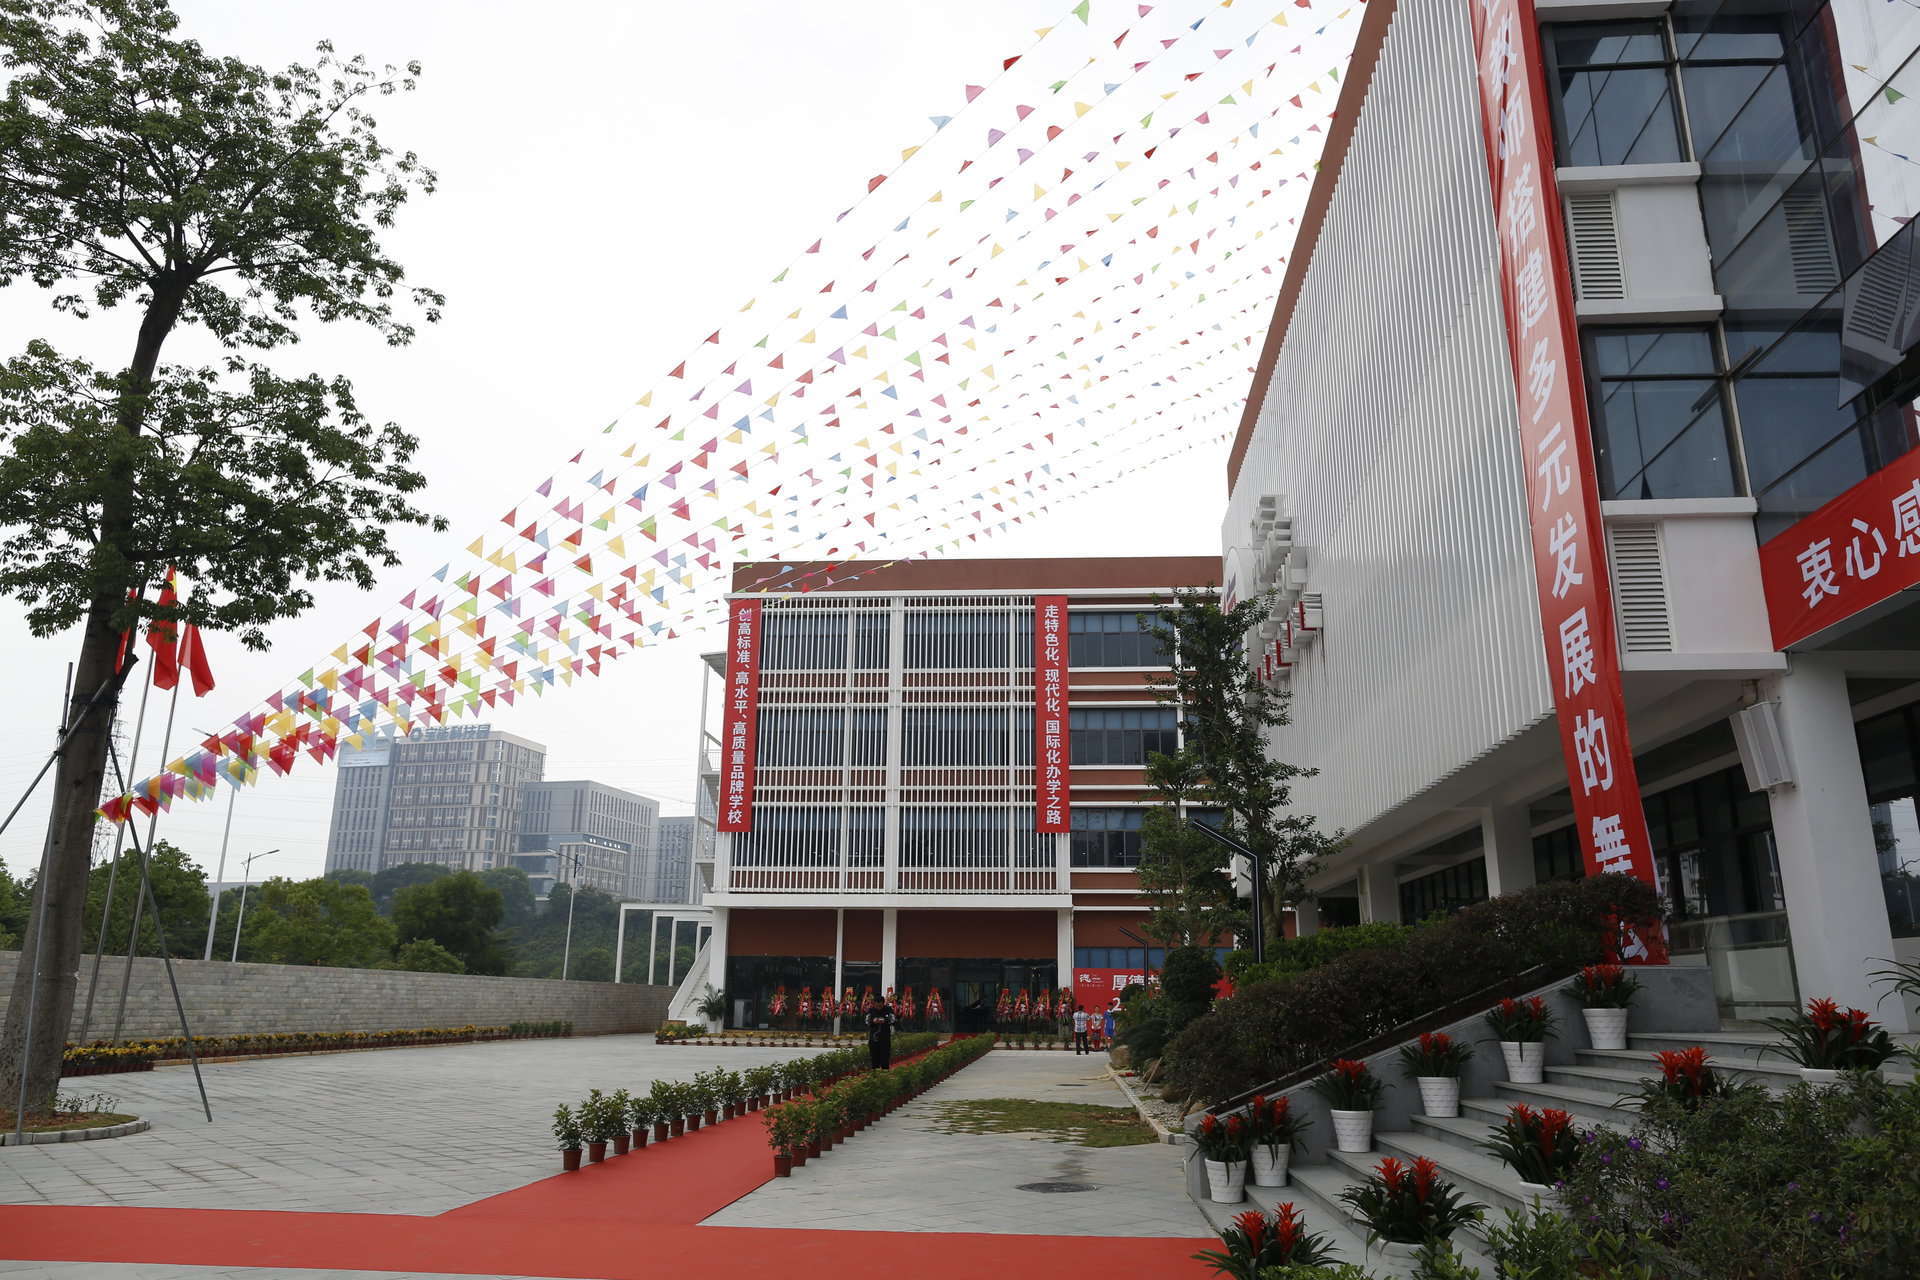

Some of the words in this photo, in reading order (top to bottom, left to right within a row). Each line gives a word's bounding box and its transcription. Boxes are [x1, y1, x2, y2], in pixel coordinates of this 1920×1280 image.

[1484, 0, 1649, 963] 教师搭建多元发展的舞
[1796, 478, 1920, 609] 衷心感
[727, 608, 752, 824] 创高标准、高水平、高质量品牌学校
[1044, 604, 1062, 825] 走特色化、现代化、国际化办学之路
